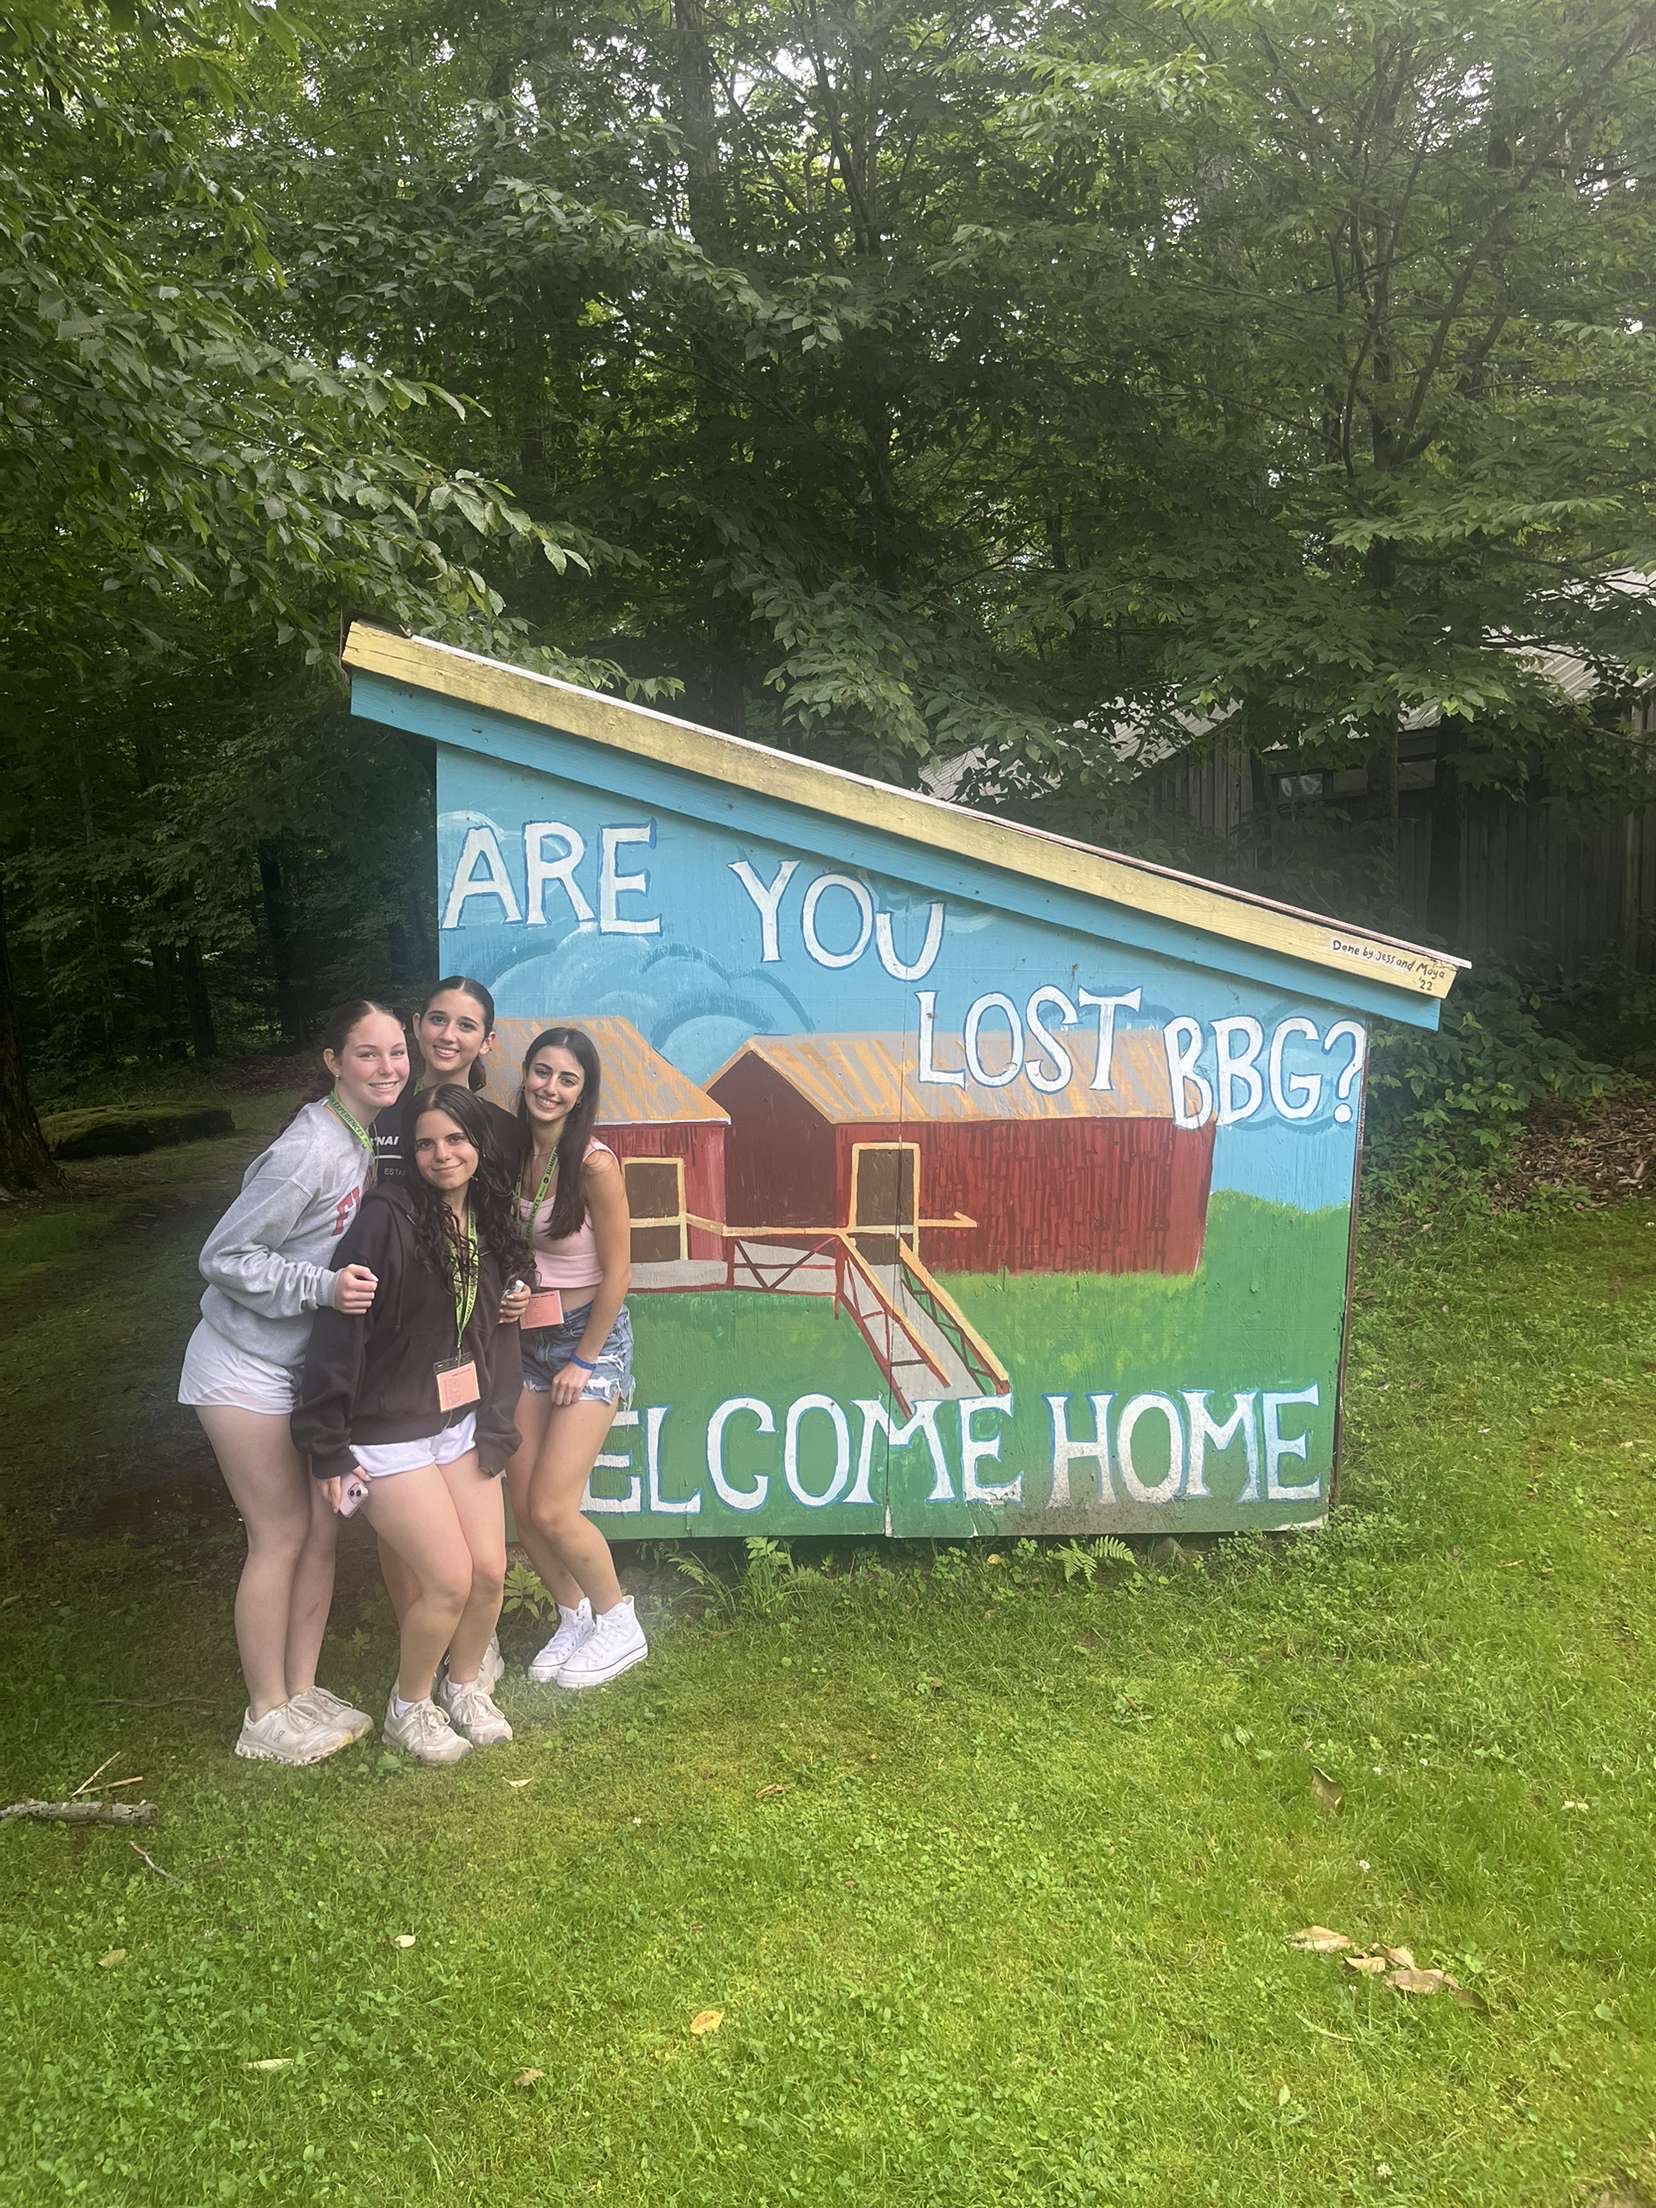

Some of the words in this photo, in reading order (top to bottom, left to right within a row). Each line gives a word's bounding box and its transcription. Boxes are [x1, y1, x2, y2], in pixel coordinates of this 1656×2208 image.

[439, 818, 662, 935] ARE
[728, 859, 945, 981] YOU
[1332, 940, 1360, 955] Done
[1363, 947, 1374, 959] by
[1396, 959, 1416, 972] and
[1418, 977, 1433, 991] '22
[916, 985, 1143, 1094] LOST
[1163, 1015, 1366, 1129] BBG?
[580, 1393, 1022, 1513] ELCOME
[1046, 1383, 1325, 1508] HOME
